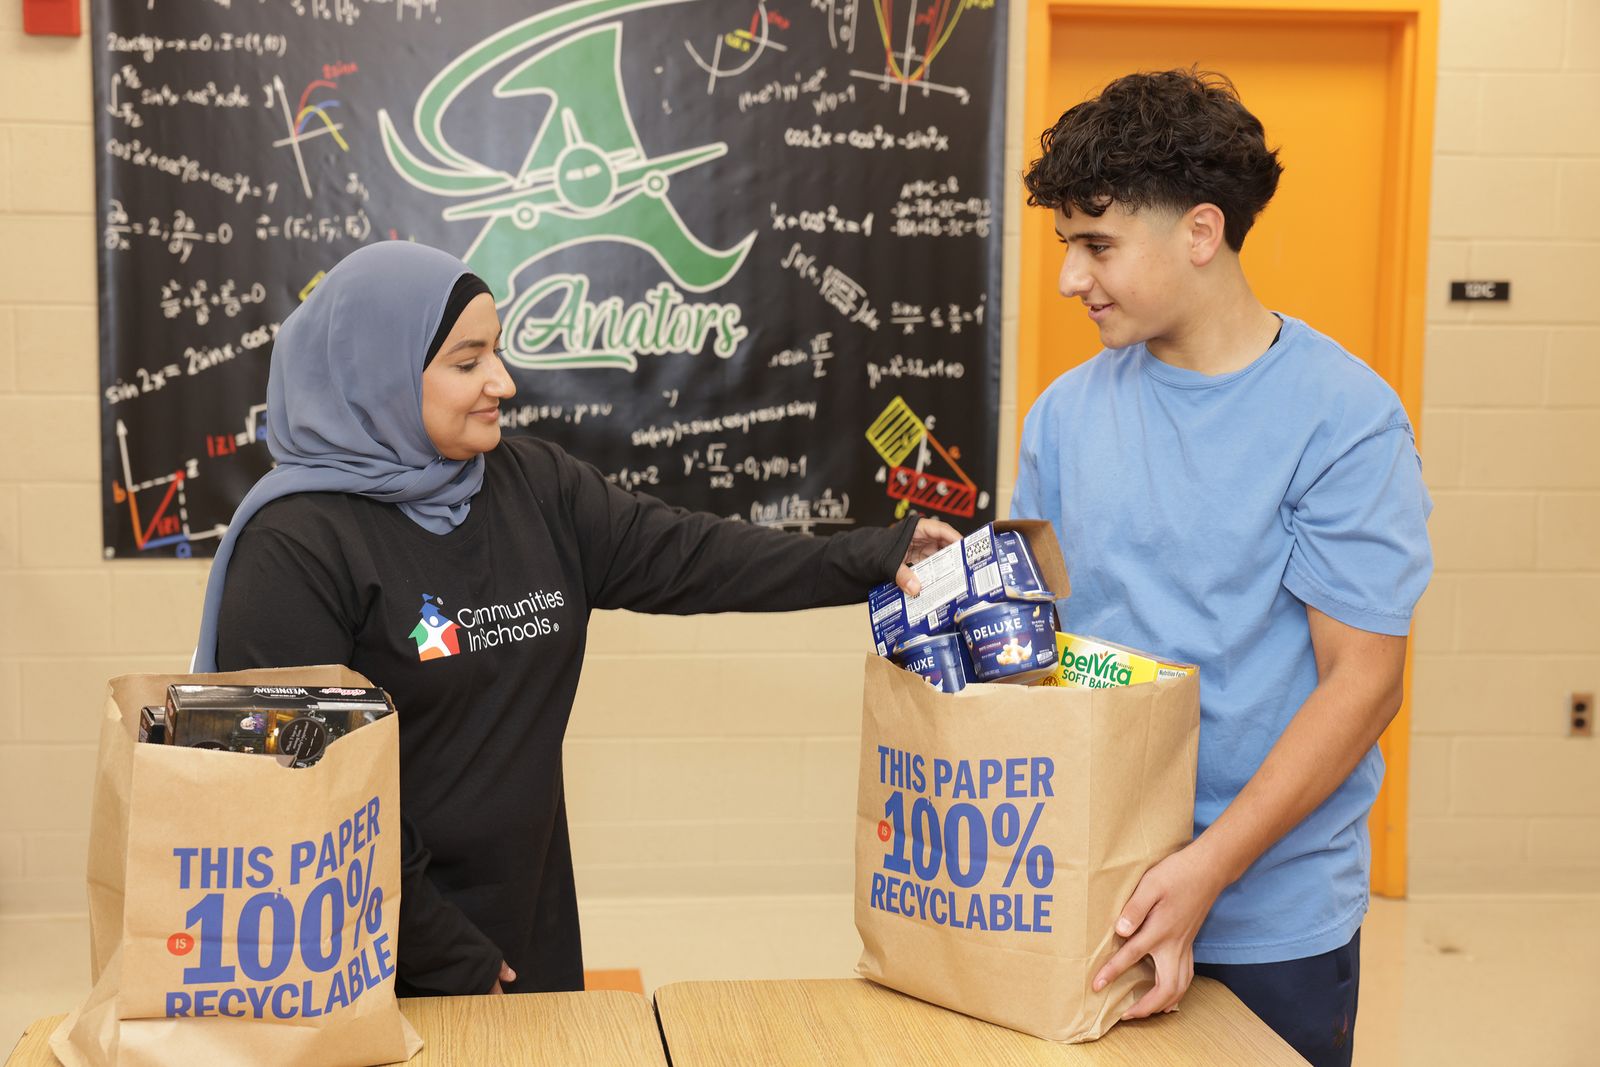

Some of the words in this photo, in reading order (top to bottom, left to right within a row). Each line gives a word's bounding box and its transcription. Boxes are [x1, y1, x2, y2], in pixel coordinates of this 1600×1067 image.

[457, 589, 565, 628] Cmmunities
[973, 618, 1022, 641] DELUXE
[253, 687, 308, 696] WEDNESDAY
[1060, 646, 1132, 686] belVita
[1062, 669, 1088, 685] SOFT
[1089, 677, 1119, 689] BAK
[877, 745, 926, 793] THIS
[933, 756, 1055, 799] PAPER
[173, 846, 274, 889] THIS
[290, 796, 381, 885] PAPER
[883, 790, 1055, 889] 100%
[175, 938, 187, 949] IS
[183, 844, 383, 985] 100%
[870, 872, 1053, 933] RECYCLABLE
[166, 933, 395, 1019] RECYCLABLE
